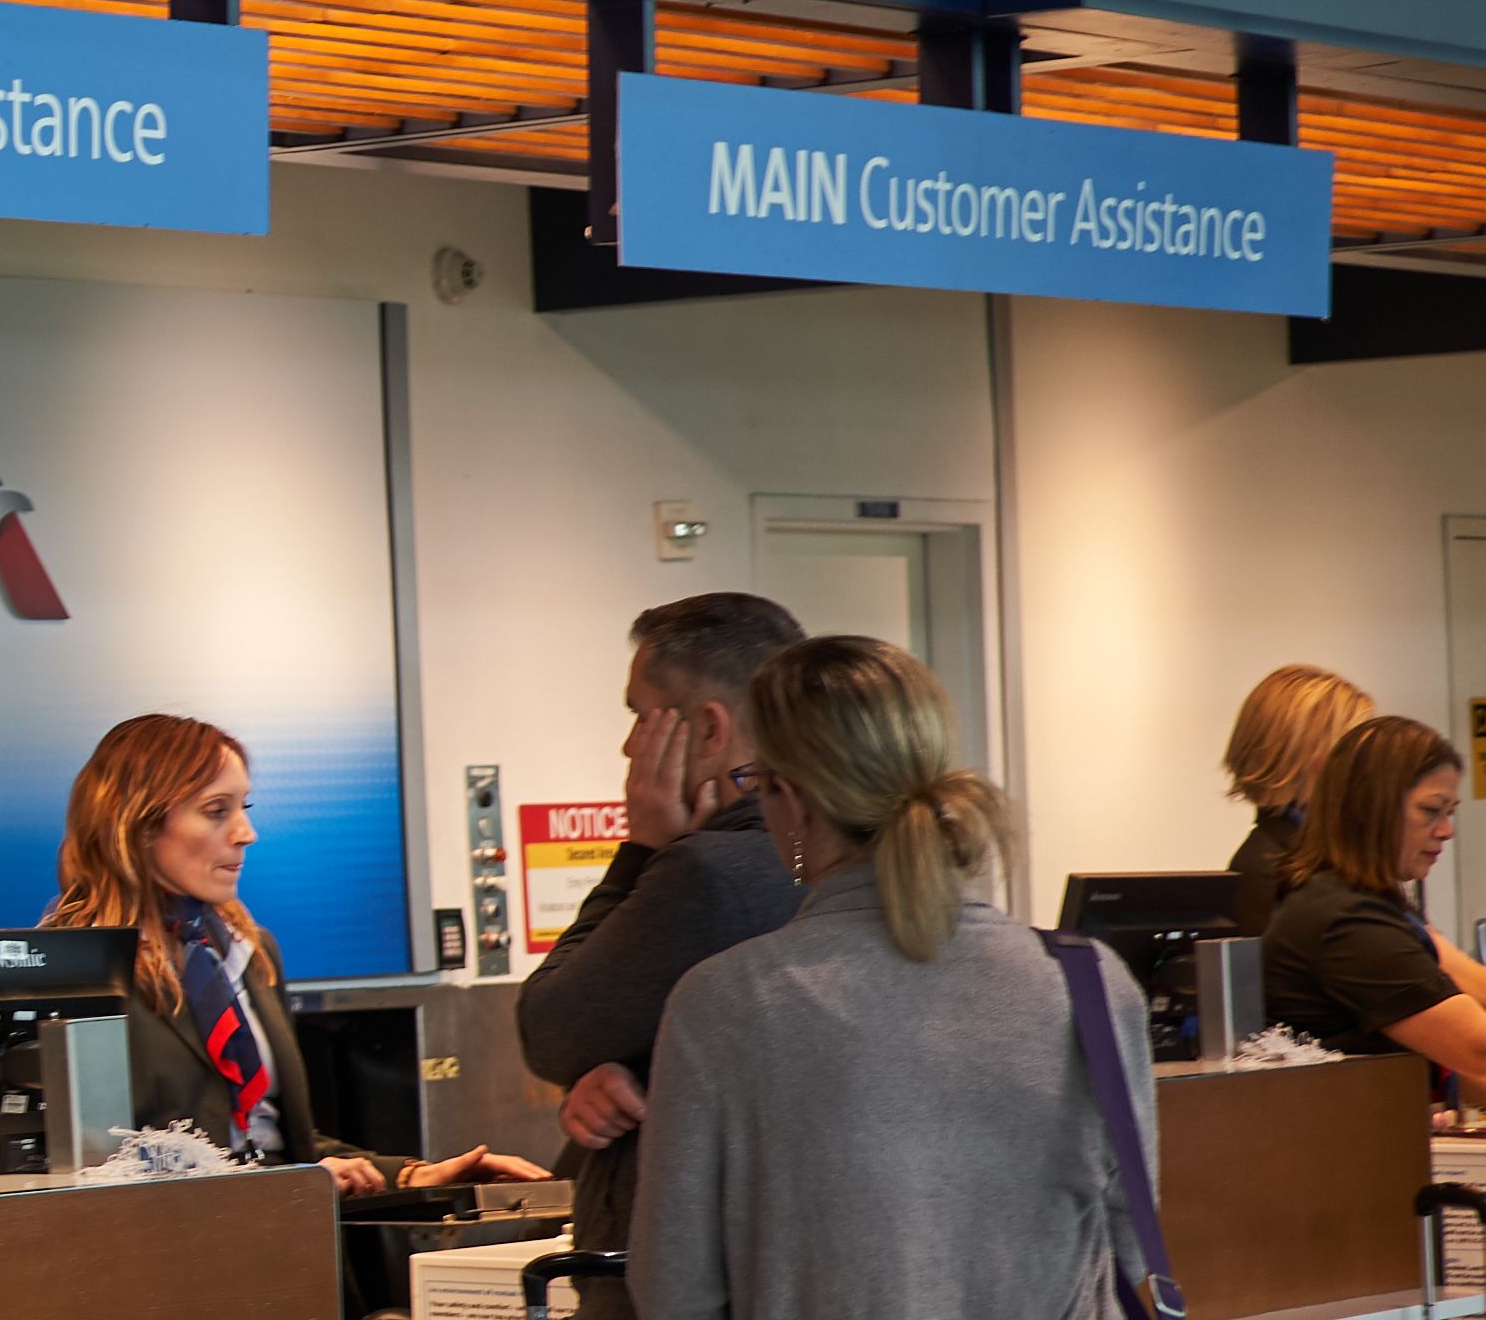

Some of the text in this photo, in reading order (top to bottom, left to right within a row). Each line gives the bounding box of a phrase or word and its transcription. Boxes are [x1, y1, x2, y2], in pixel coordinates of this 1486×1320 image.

[707, 139, 1267, 263] MAIN Customer Assistance
[548, 806, 630, 840] NOTICE
